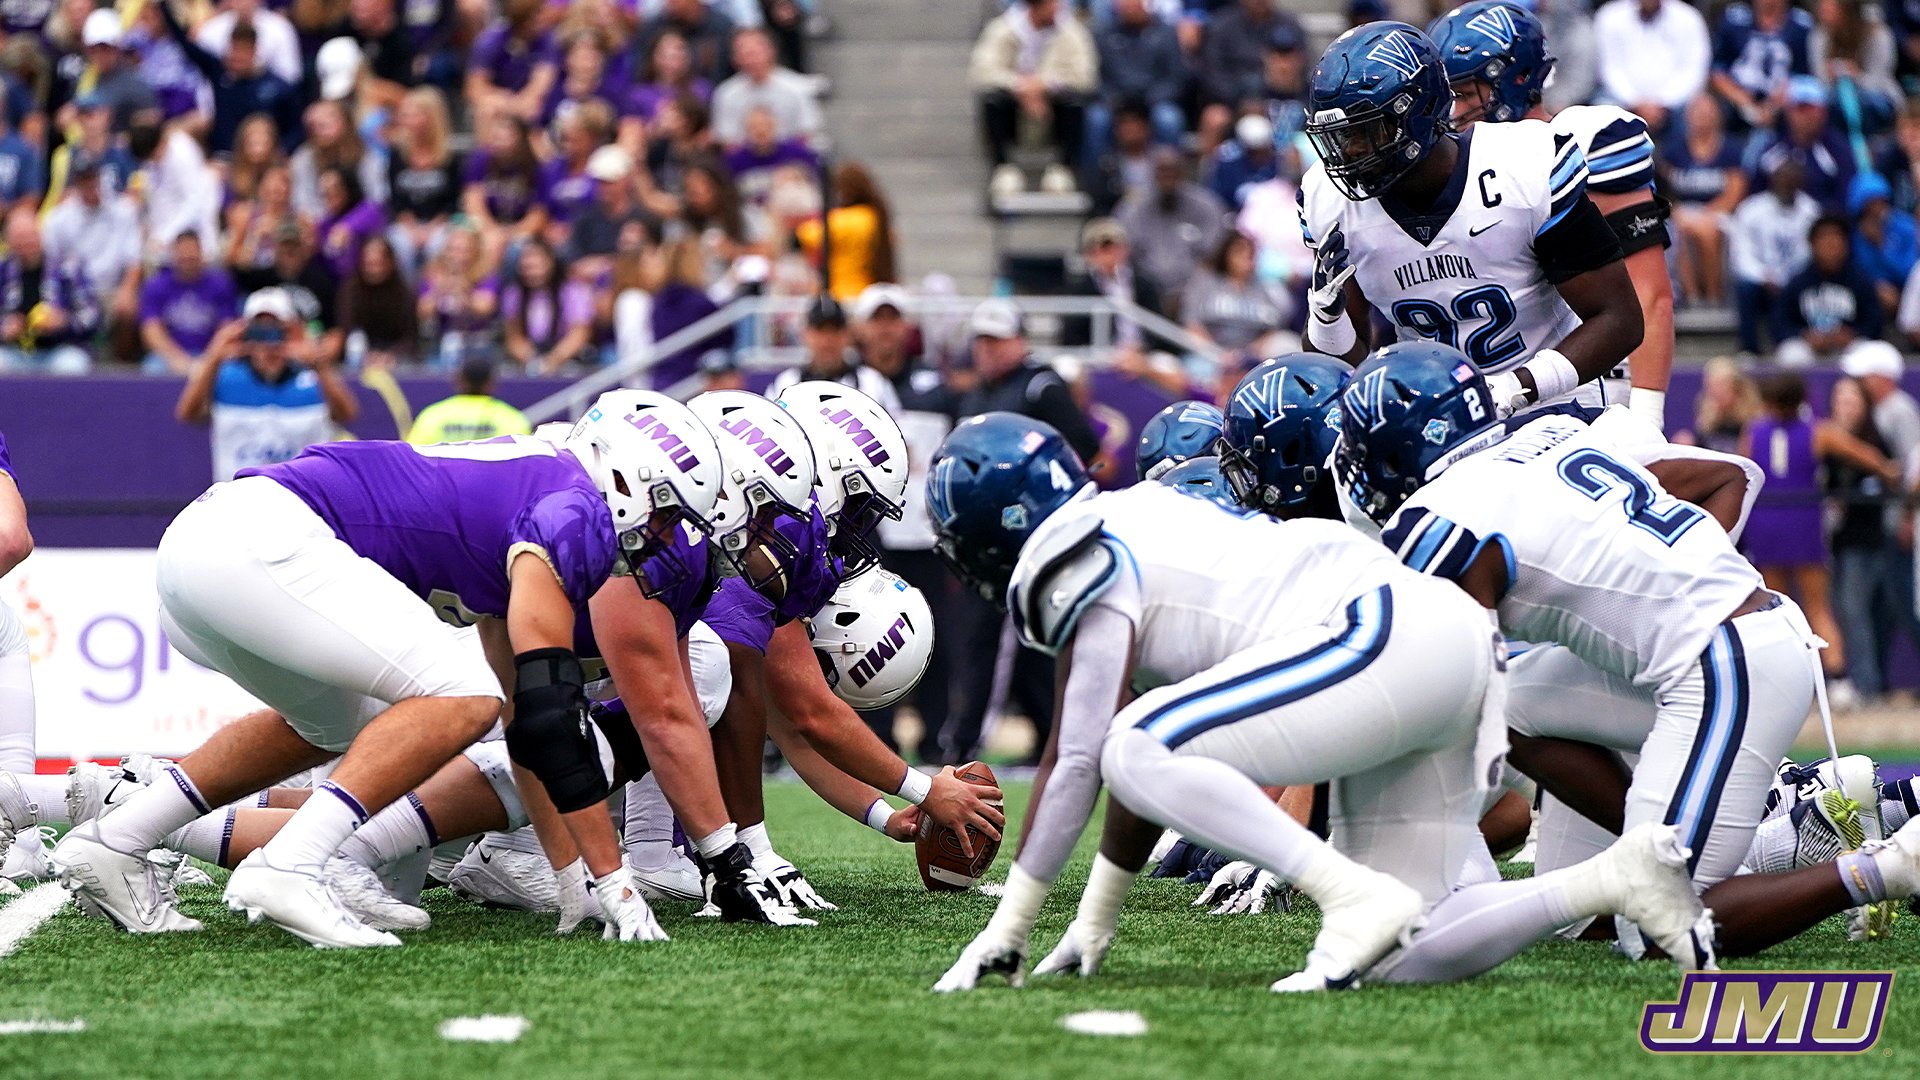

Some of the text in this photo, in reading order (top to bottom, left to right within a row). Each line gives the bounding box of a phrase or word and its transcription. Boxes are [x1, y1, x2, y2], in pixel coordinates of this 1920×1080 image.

[1365, 29, 1424, 80] V
[1478, 168, 1502, 209] C
[1393, 253, 1478, 291] VILLANOVA
[1391, 284, 1527, 369] 92
[1234, 366, 1288, 429] V
[1463, 386, 1486, 422] 2
[623, 413, 701, 474] JMU
[718, 418, 795, 477] JMU
[820, 407, 890, 468] JMU
[1049, 458, 1075, 492] 4
[1556, 447, 1707, 548] 2
[847, 617, 926, 689] JMU
